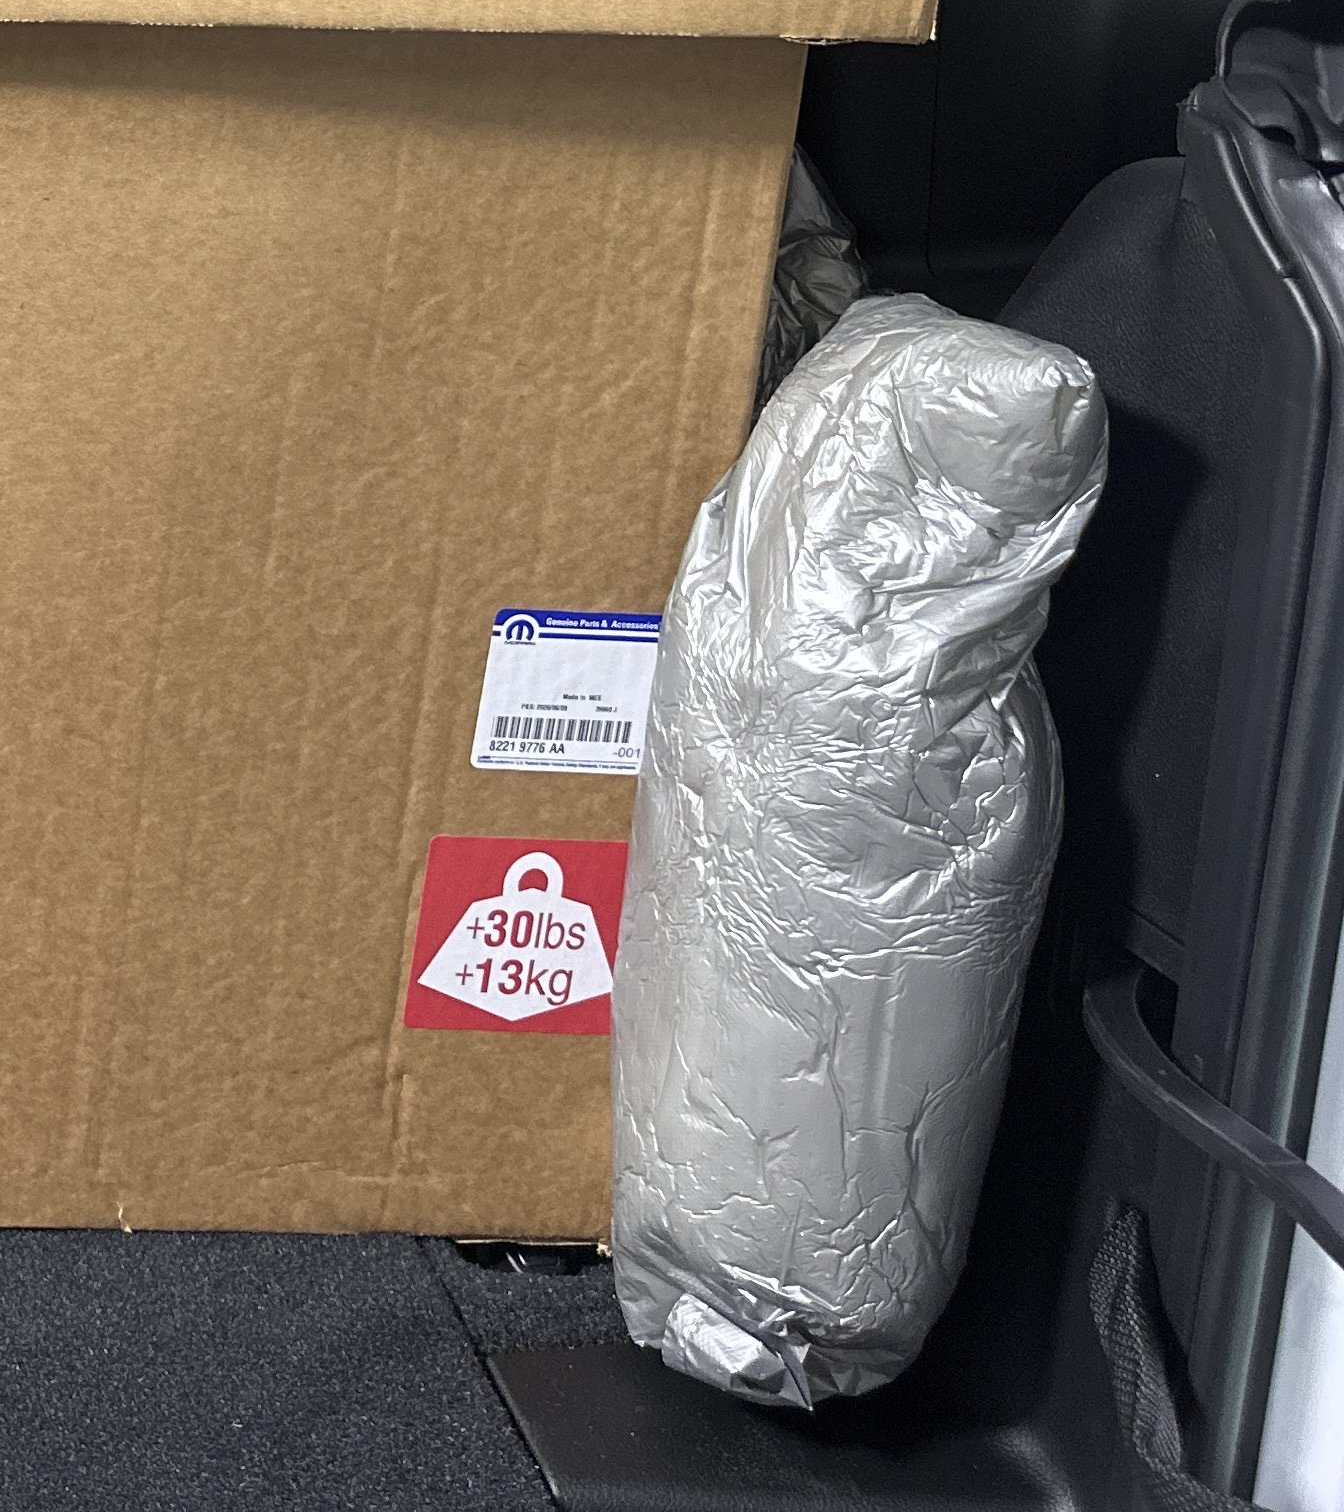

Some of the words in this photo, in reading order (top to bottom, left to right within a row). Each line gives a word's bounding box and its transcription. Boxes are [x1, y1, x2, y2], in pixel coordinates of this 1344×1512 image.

[546, 617, 578, 627] Genuine
[579, 619, 599, 628] Parts
[600, 619, 608, 628] &
[611, 620, 659, 631] Accessories
[489, 740, 515, 751] 8221
[518, 741, 545, 753] 9776
[549, 743, 565, 754] AA
[612, 747, 641, 759] -001
[466, 909, 586, 950] +30lbs
[455, 958, 573, 1006] +13kg
